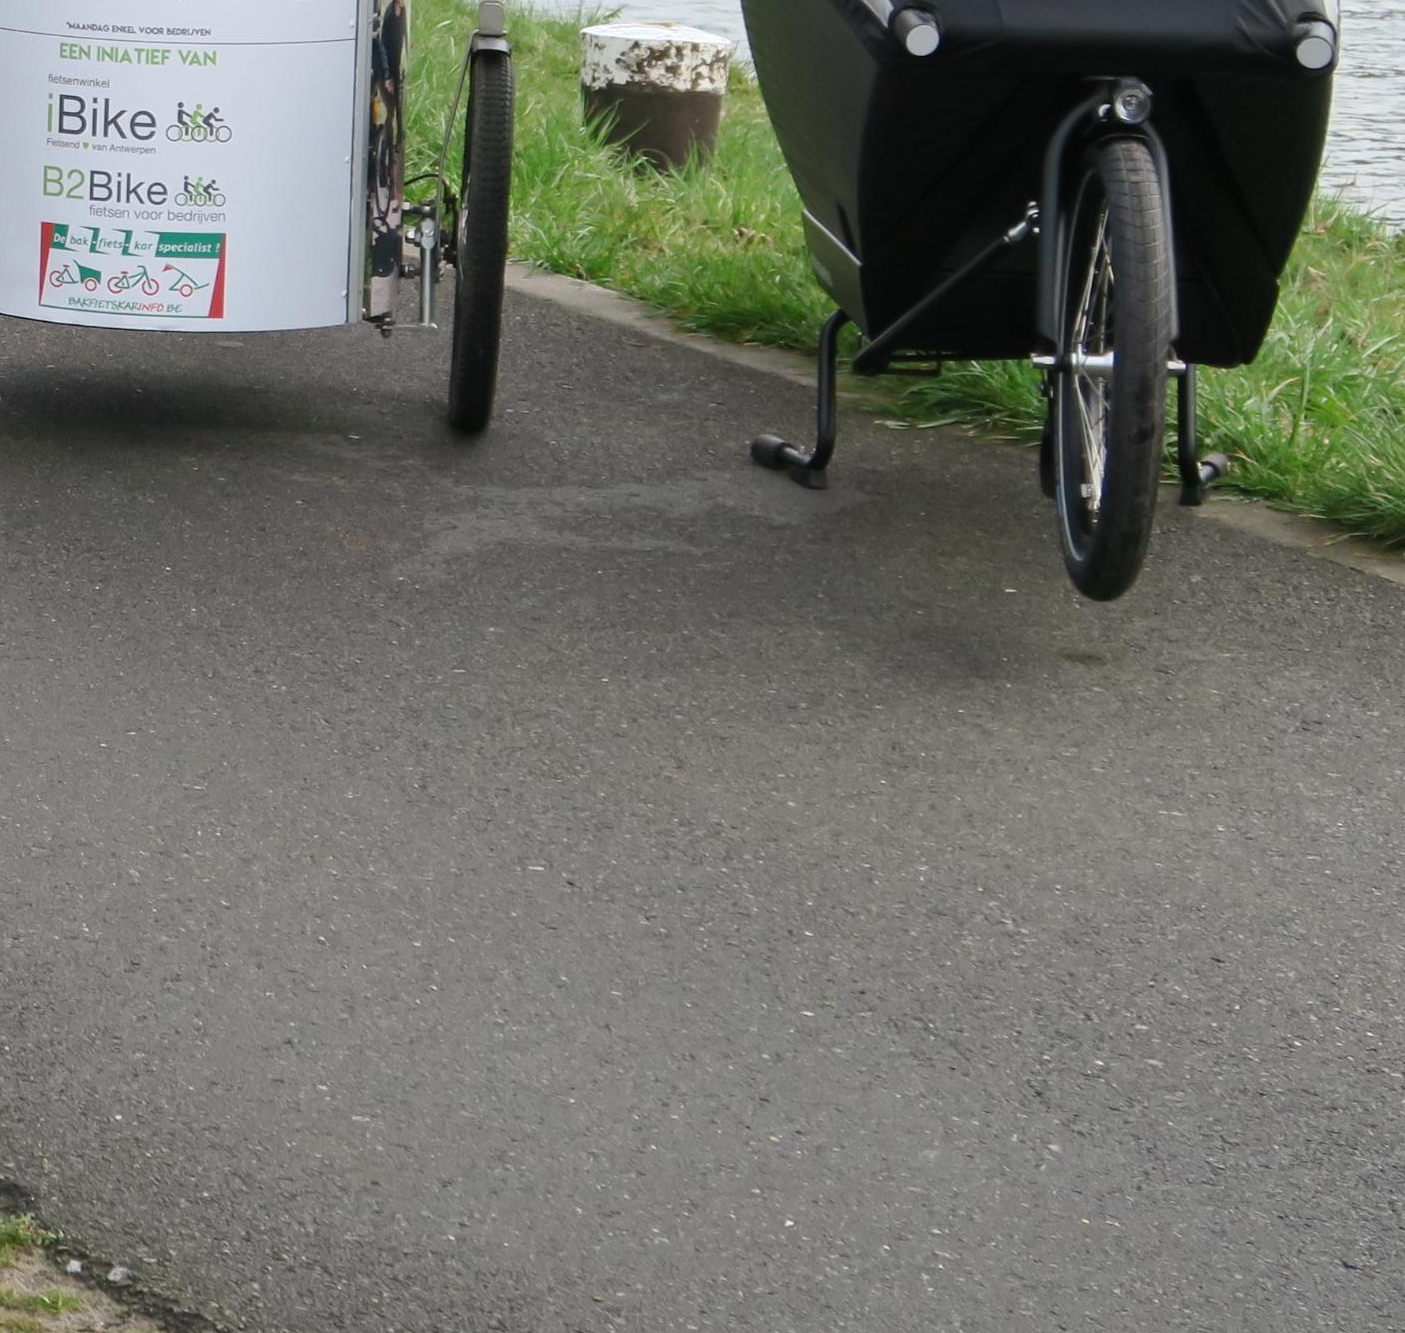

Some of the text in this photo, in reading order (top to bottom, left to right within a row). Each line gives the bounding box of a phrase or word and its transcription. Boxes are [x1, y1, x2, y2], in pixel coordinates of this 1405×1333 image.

[111, 25, 136, 34] ENKEL
[138, 27, 164, 36] VOOR
[166, 27, 212, 36] BEDRIJVEN
[59, 43, 217, 67] EEN INIATIEF VAN
[48, 74, 111, 88] fietsenwinkel
[47, 93, 157, 141] iBike
[46, 138, 157, 155] Fietsend van Antwerpen
[42, 165, 168, 206] B2Bike
[89, 205, 226, 225] fietsen voor bedrijven
[53, 233, 66, 244] De
[68, 297, 183, 314] BAKFIETSKARINFO.BE
